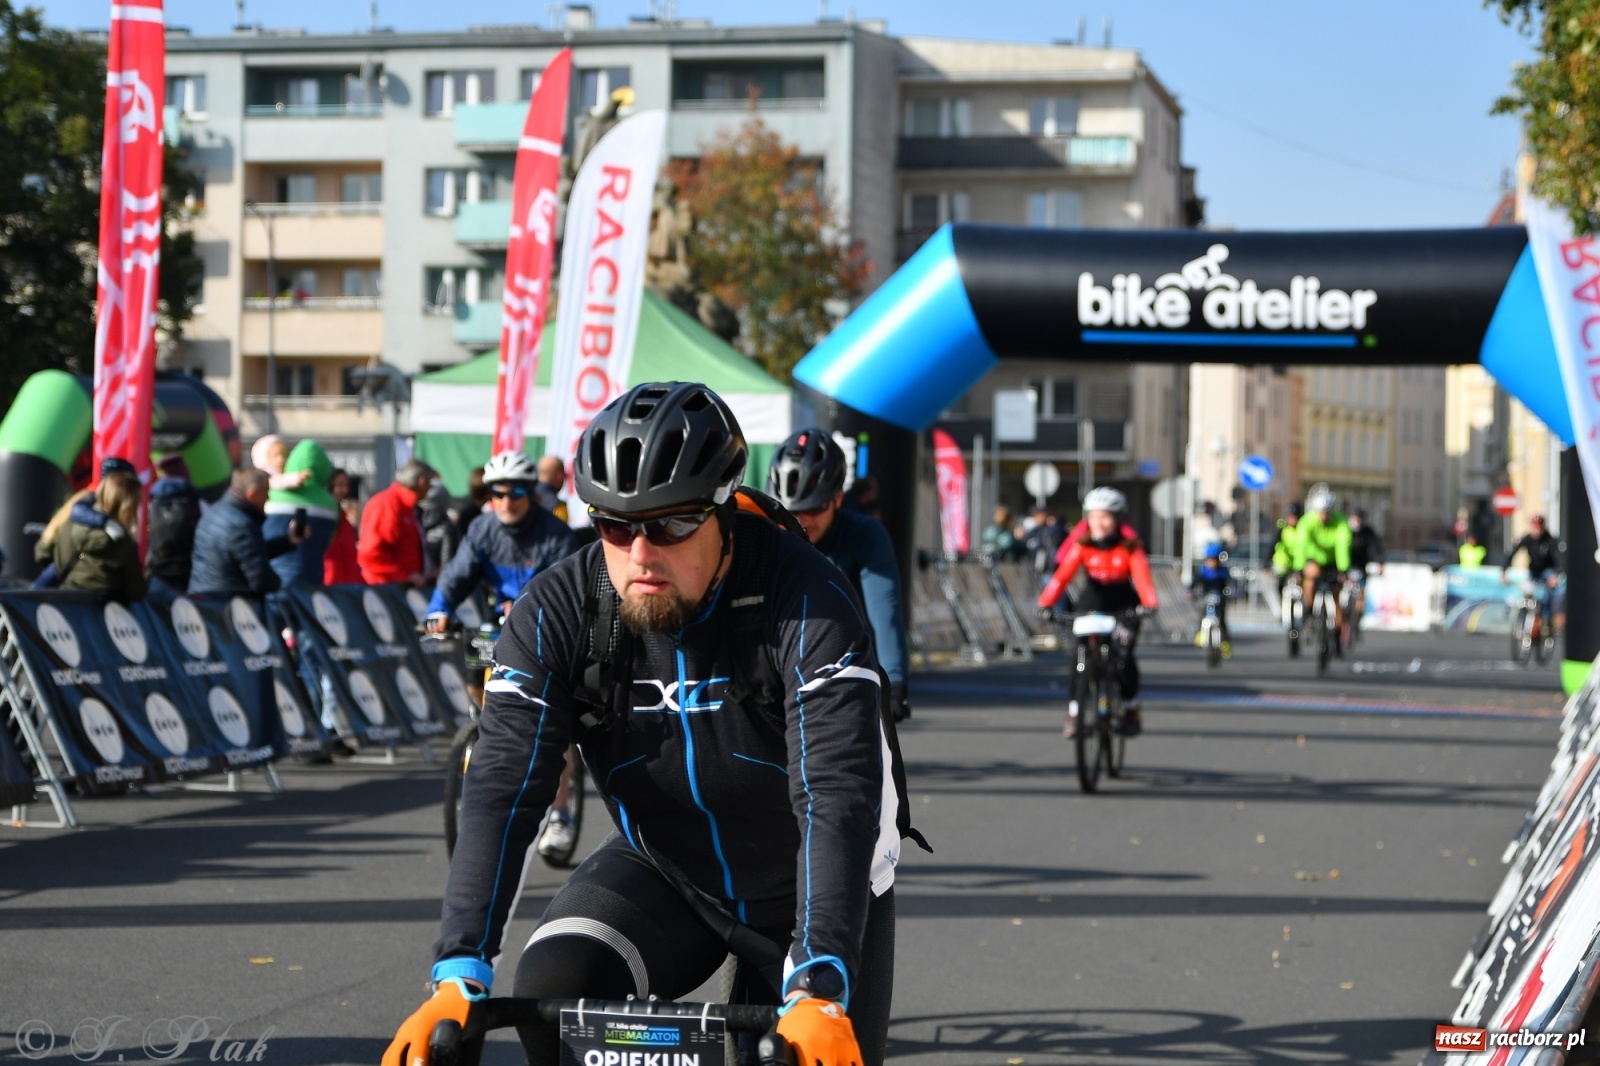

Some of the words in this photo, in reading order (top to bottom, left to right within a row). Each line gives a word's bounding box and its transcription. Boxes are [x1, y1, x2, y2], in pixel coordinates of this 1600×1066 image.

[566, 164, 632, 496] RACIBÓ
[1077, 271, 1191, 329] bike
[1202, 274, 1378, 331] atelier
